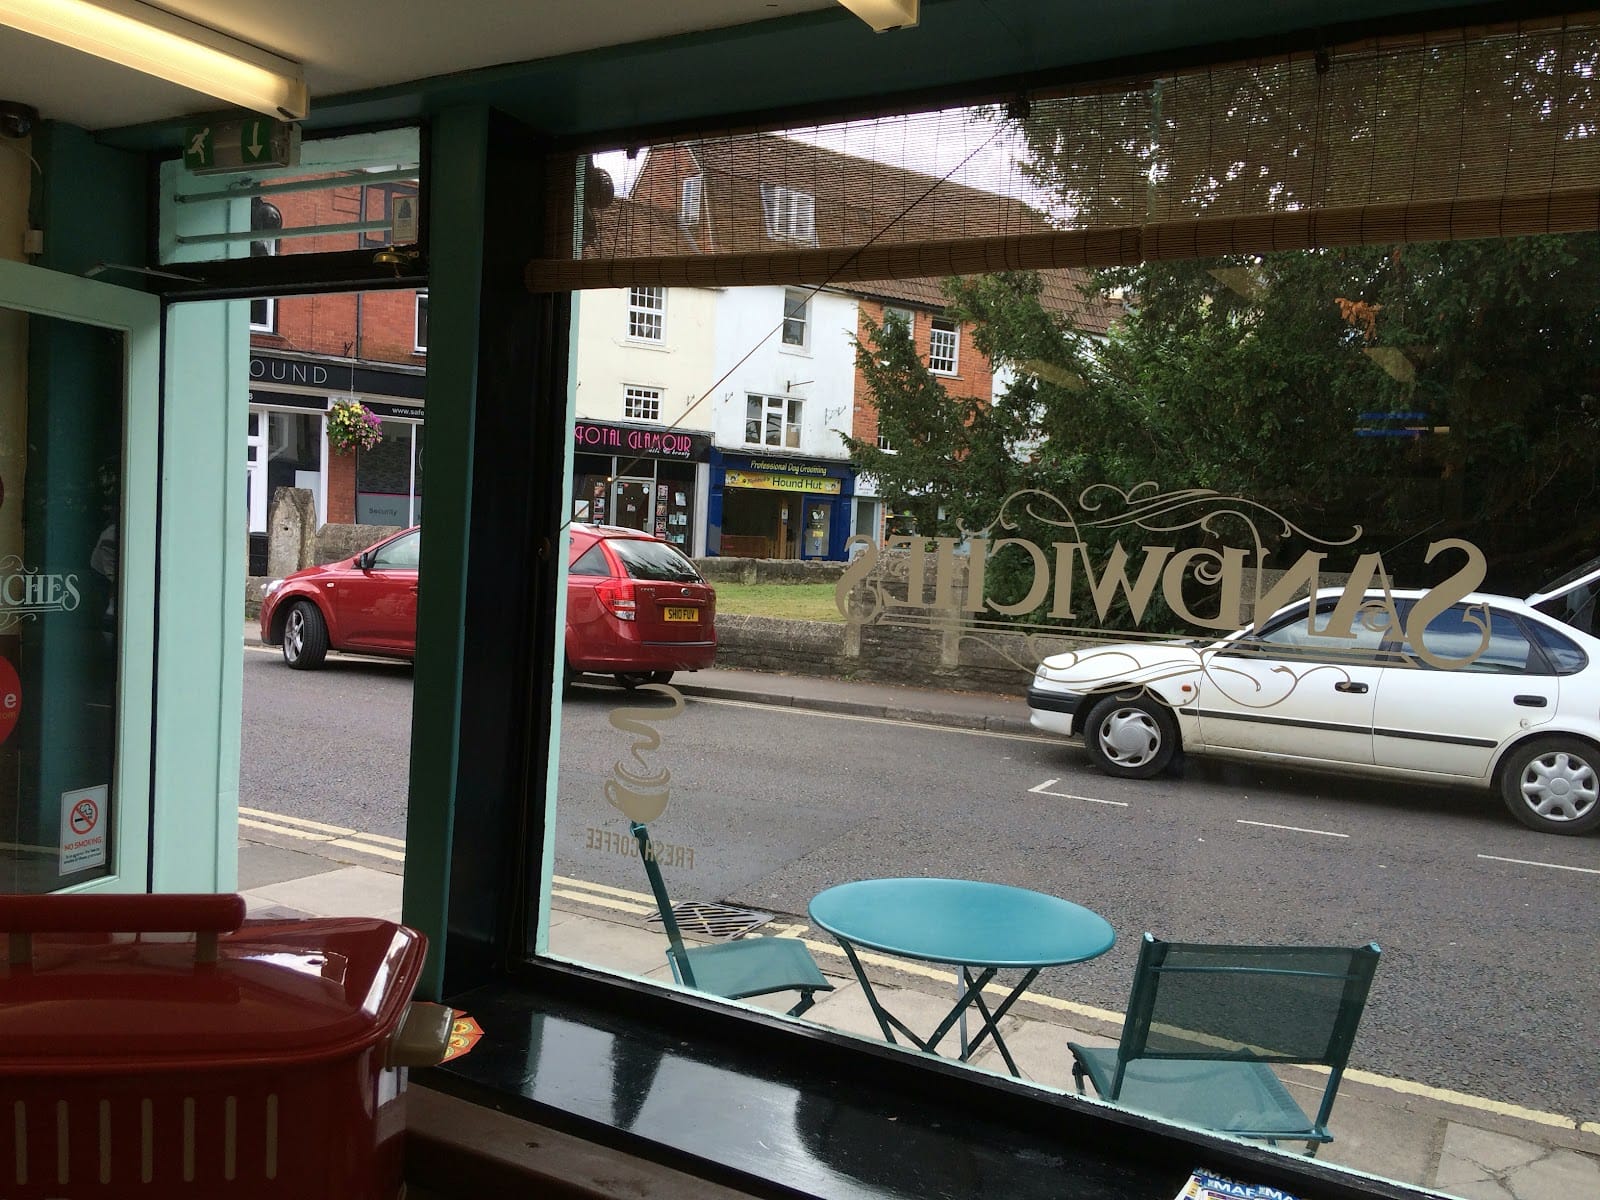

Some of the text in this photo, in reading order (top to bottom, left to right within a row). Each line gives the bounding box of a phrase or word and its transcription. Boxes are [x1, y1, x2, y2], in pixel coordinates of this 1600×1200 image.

[249, 359, 328, 385] OUND
[575, 426, 692, 451] TOTAL GLAMOUR
[751, 460, 787, 471] Professional
[800, 464, 827, 476] Grooming
[772, 477, 803, 489] Hound
[805, 480, 822, 490] Hut
[368, 506, 398, 517] Security
[64, 836, 102, 851] NO SMOKING
